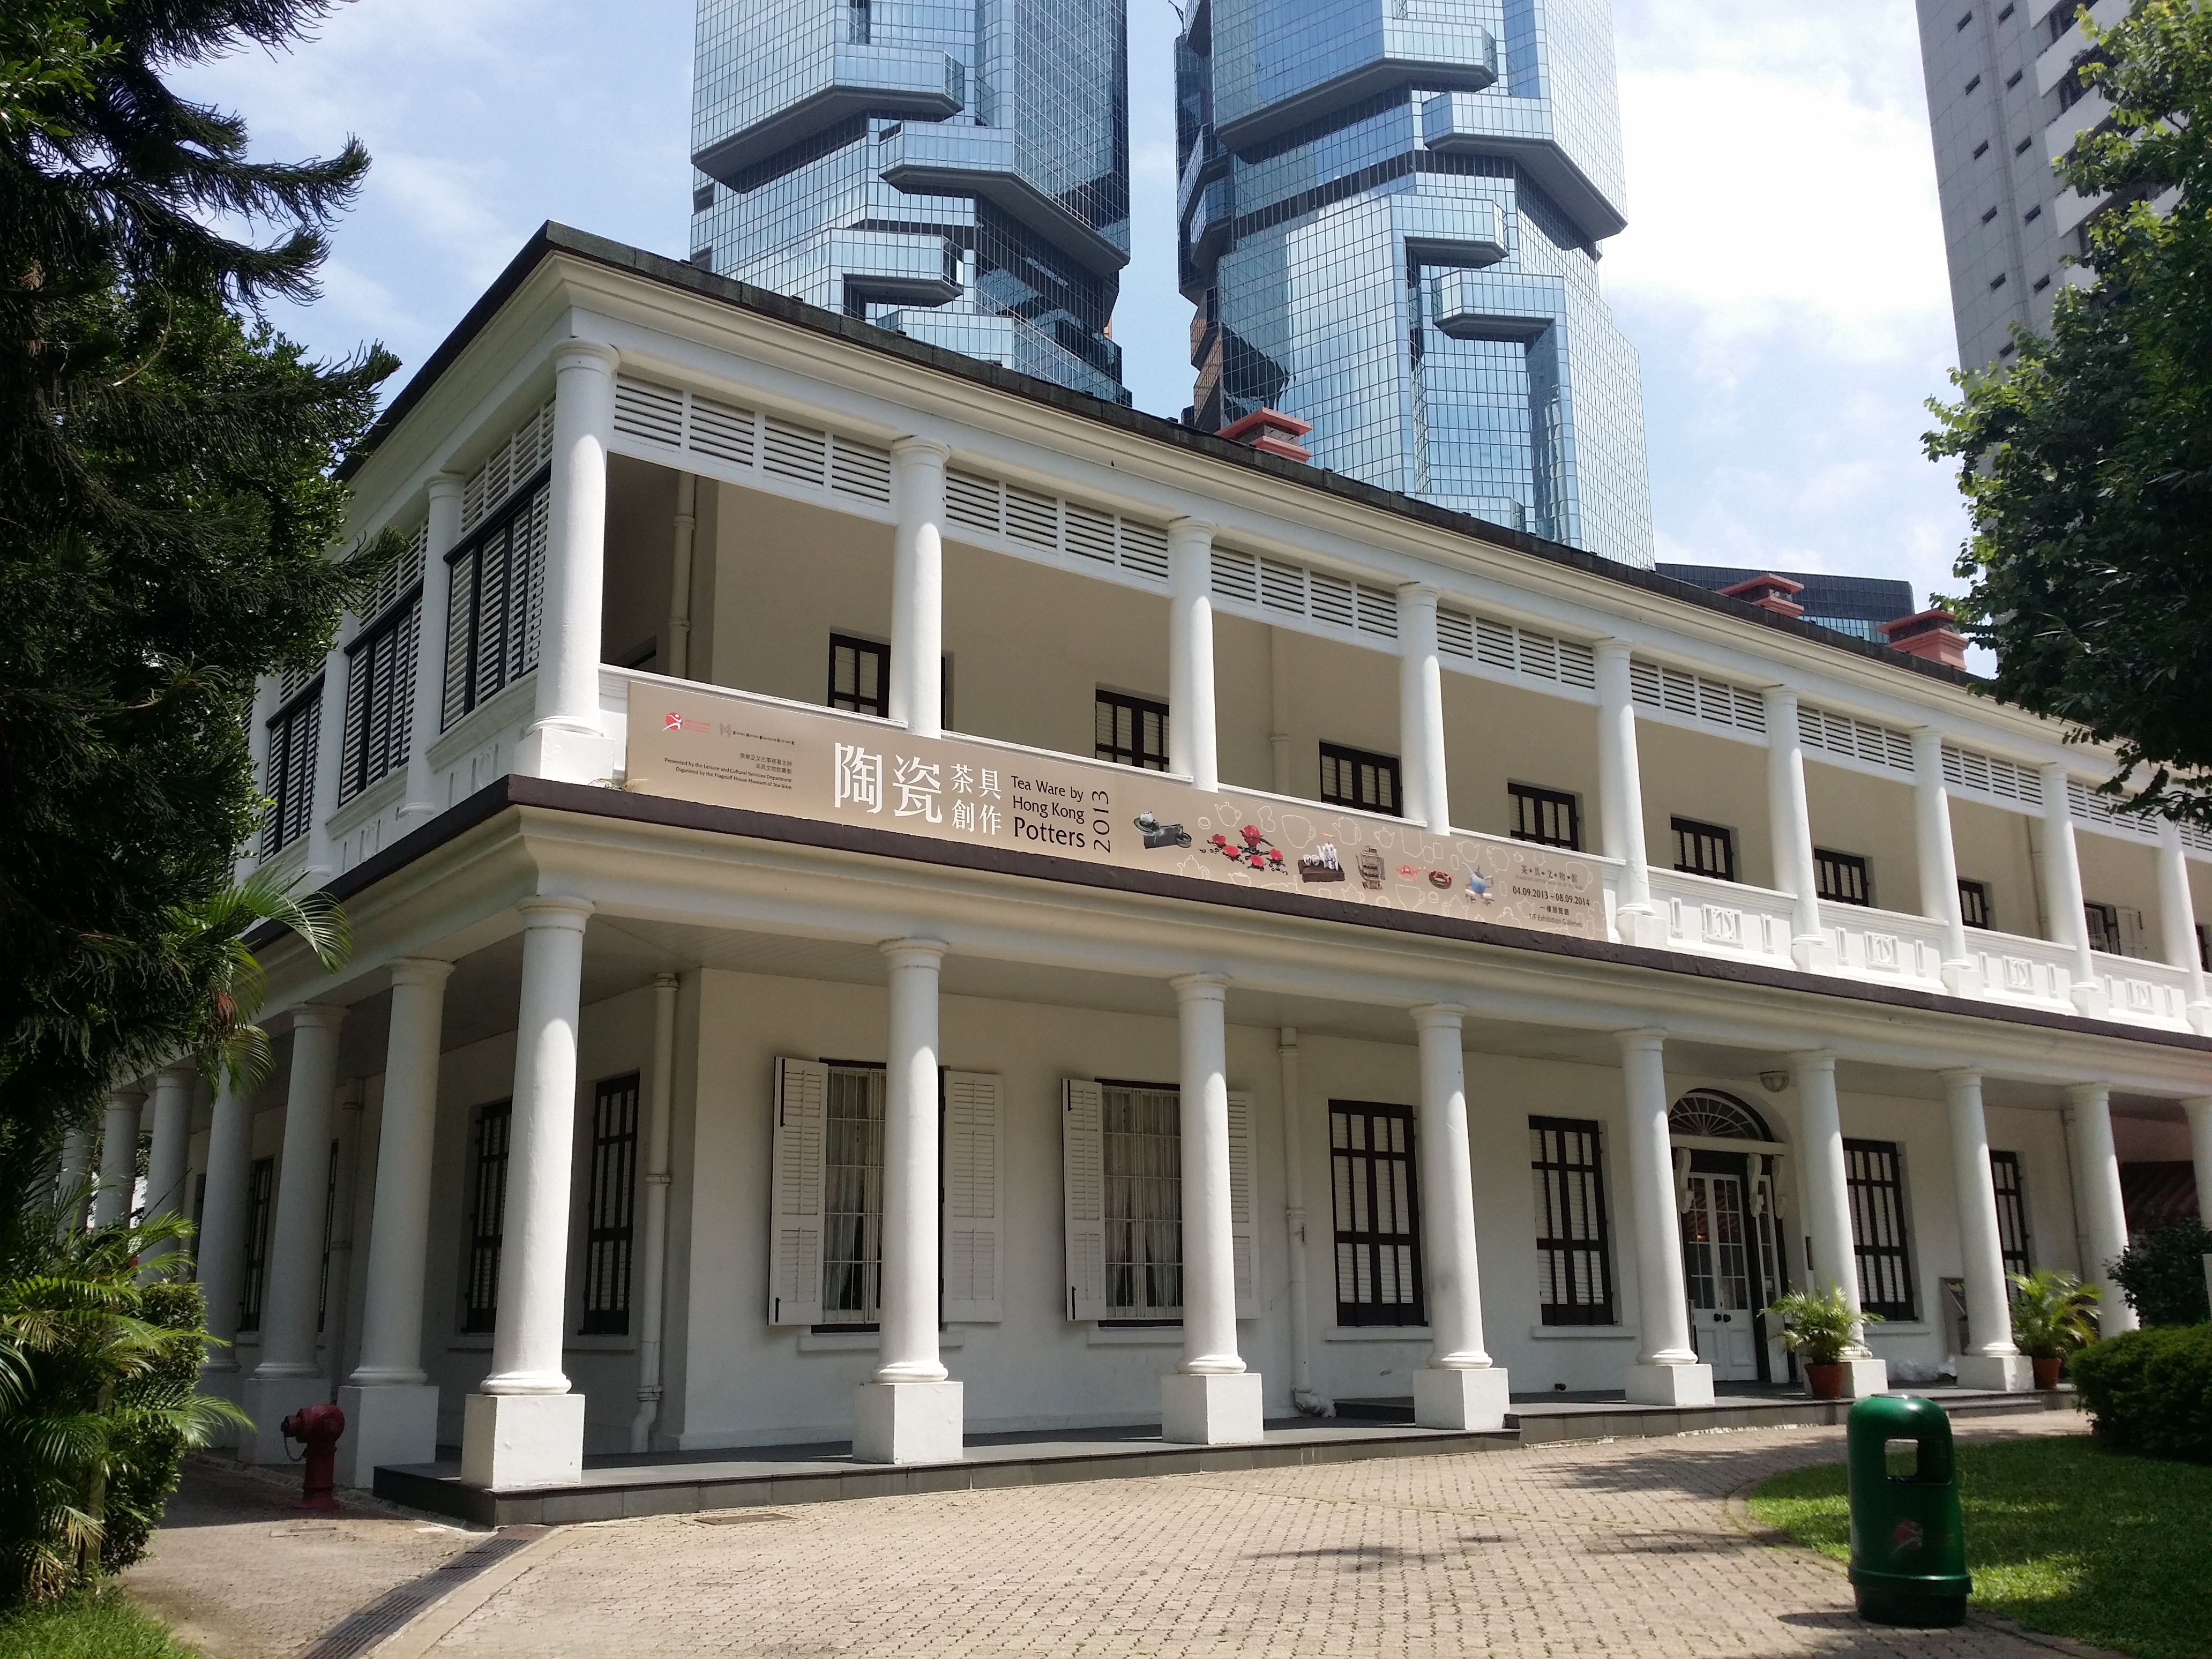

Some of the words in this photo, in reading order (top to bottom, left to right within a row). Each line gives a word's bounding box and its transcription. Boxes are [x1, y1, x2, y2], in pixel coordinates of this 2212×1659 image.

[664, 758, 687, 766] Presented
[766, 774, 791, 782] Department
[676, 767, 698, 775] Organised
[834, 742, 943, 824] 陶瓷
[950, 763, 1002, 800] 茶具
[1011, 775, 1032, 790] Tea
[1036, 780, 1065, 797] Ware
[1071, 786, 1084, 802] by
[952, 799, 1002, 835] 創作
[1012, 795, 1048, 818] Hong
[1052, 802, 1085, 825] Kong
[1092, 790, 1110, 854] 2013
[1014, 816, 1086, 848] Potters
[1513, 886, 1549, 899] 04.09.2013
[1556, 893, 1590, 906] 08.09.2014
[1537, 914, 1561, 924] Exhibition
